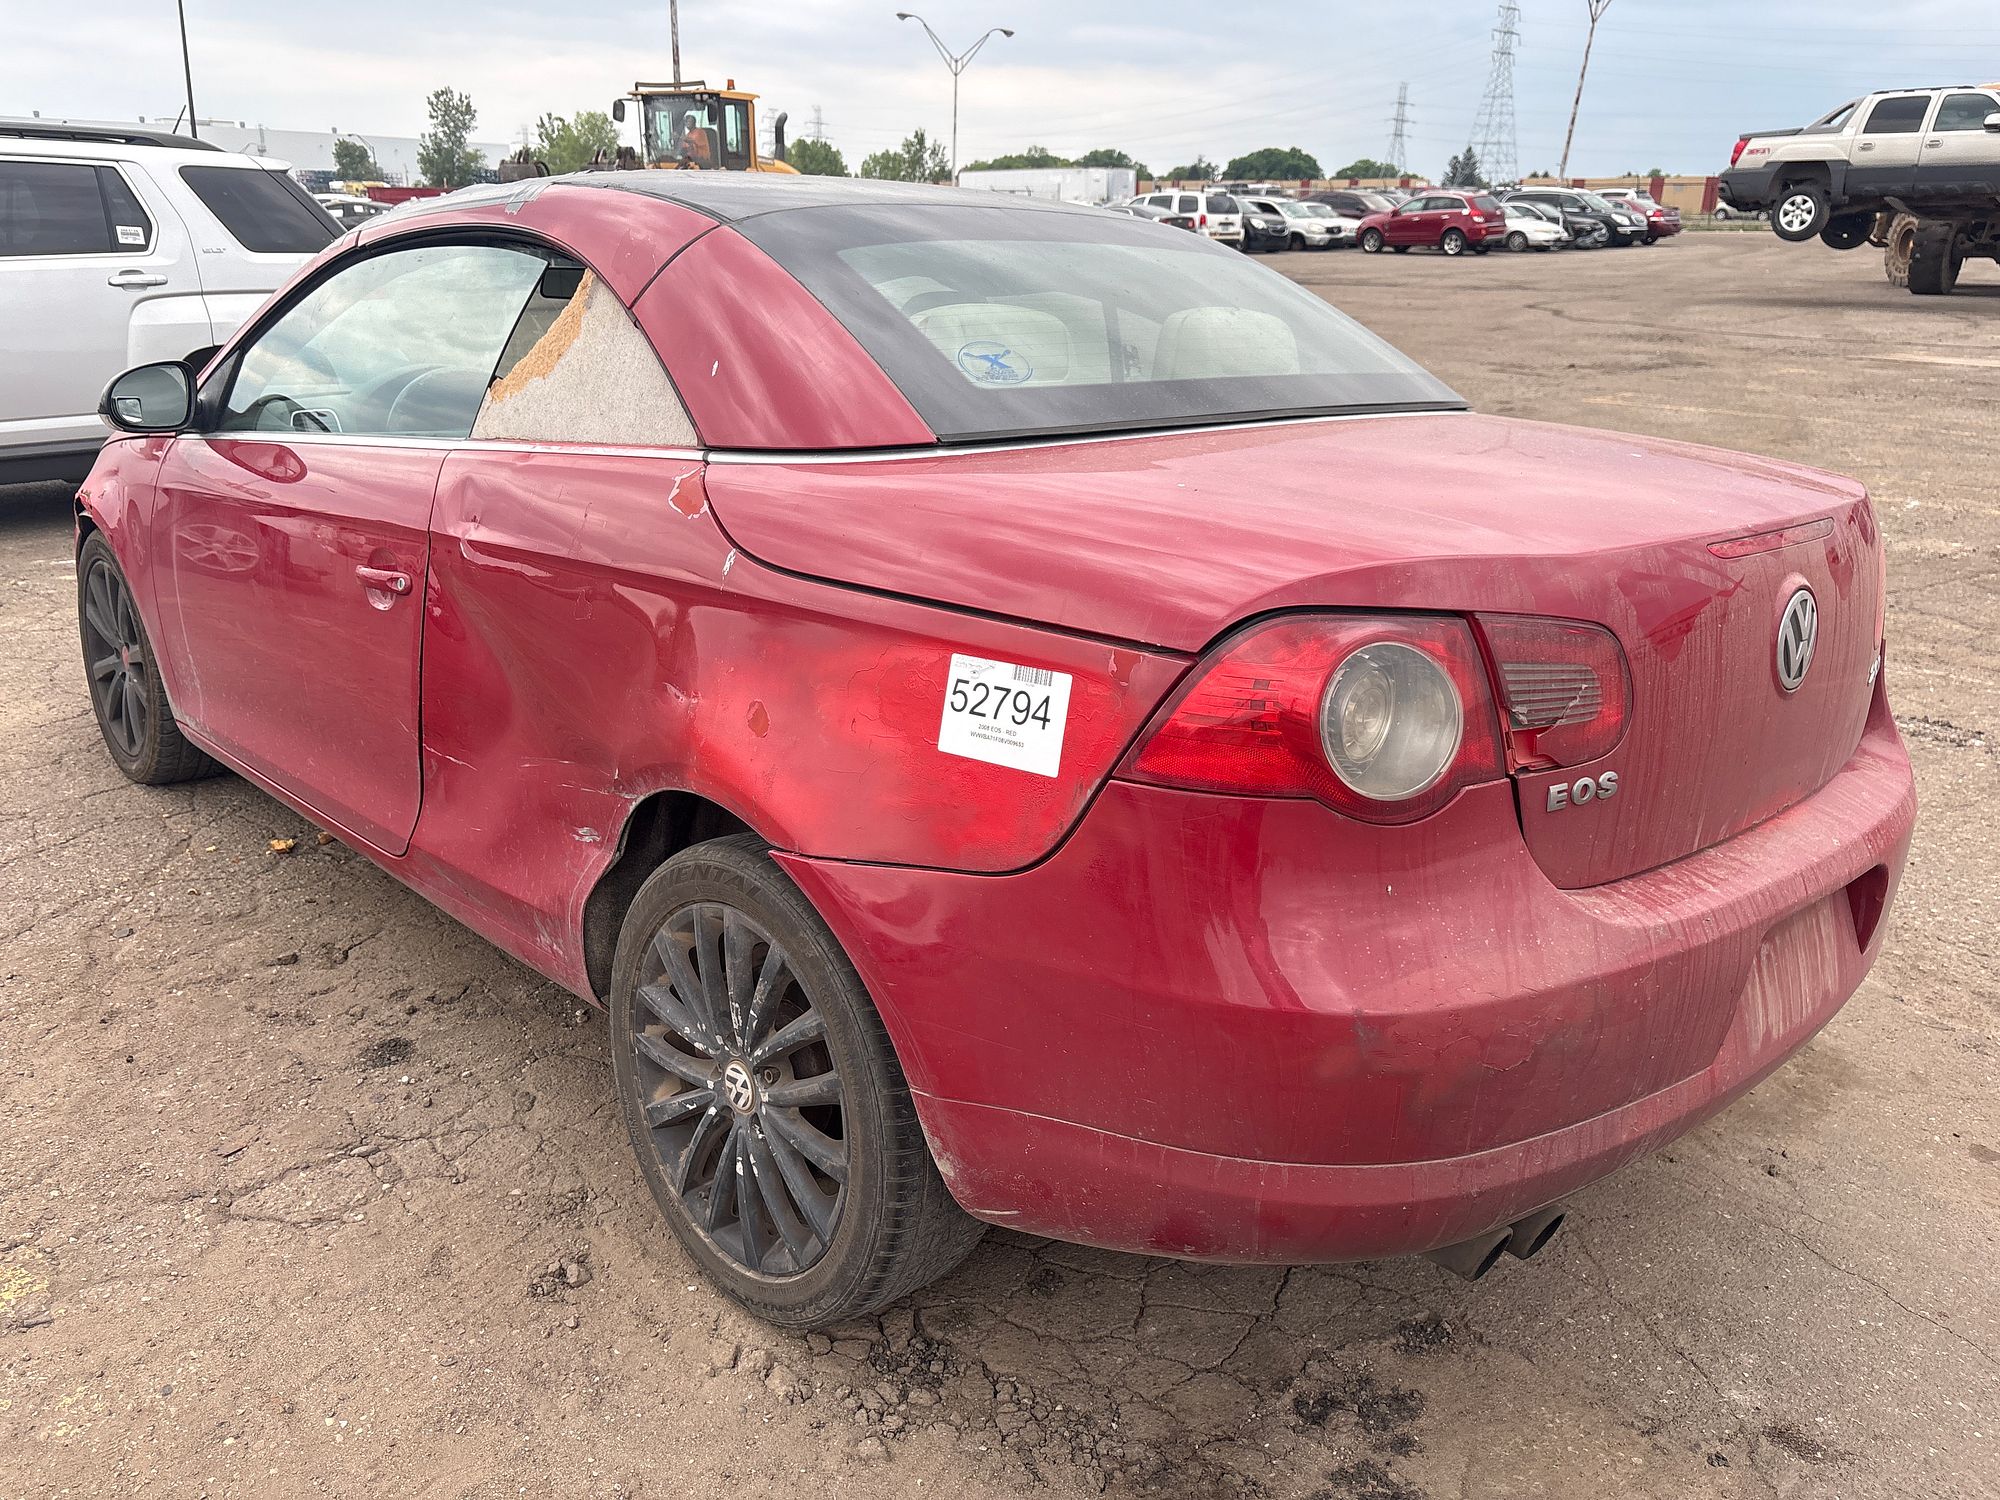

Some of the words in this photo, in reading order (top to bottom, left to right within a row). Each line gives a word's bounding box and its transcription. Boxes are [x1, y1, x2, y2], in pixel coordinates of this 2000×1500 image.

[950, 678, 1051, 730] 52794
[990, 726, 1002, 734] EOS
[1005, 729, 1017, 737] RED
[1546, 770, 1619, 812] EOS
